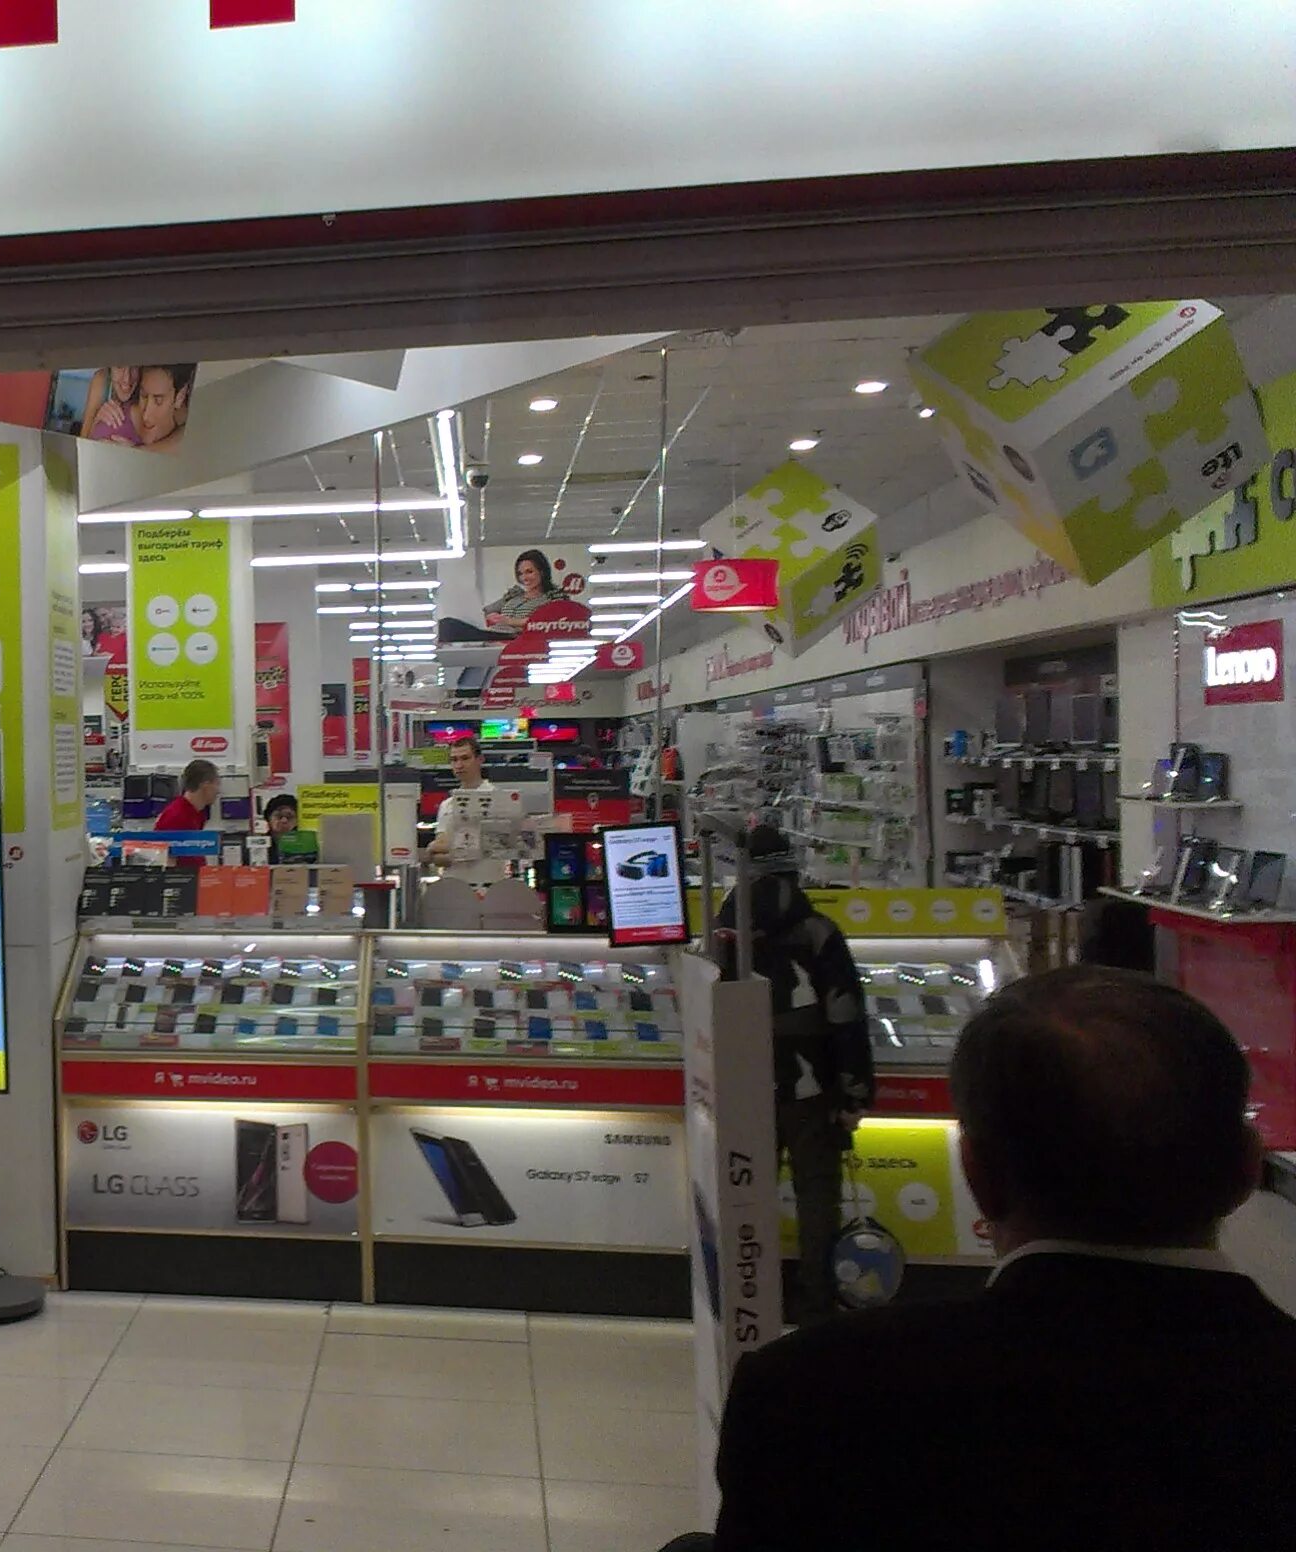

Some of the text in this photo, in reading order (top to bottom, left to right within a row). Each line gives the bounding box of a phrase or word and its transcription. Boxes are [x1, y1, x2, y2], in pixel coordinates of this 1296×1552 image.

[101, 1125, 128, 1142] LG
[604, 1133, 671, 1146] SAMSUNG
[525, 1168, 573, 1184] Galaxy
[575, 1170, 591, 1182] S7
[728, 1151, 753, 1187] S7
[93, 1174, 200, 1197] LG CLASS
[734, 1223, 762, 1343] S7 edge
